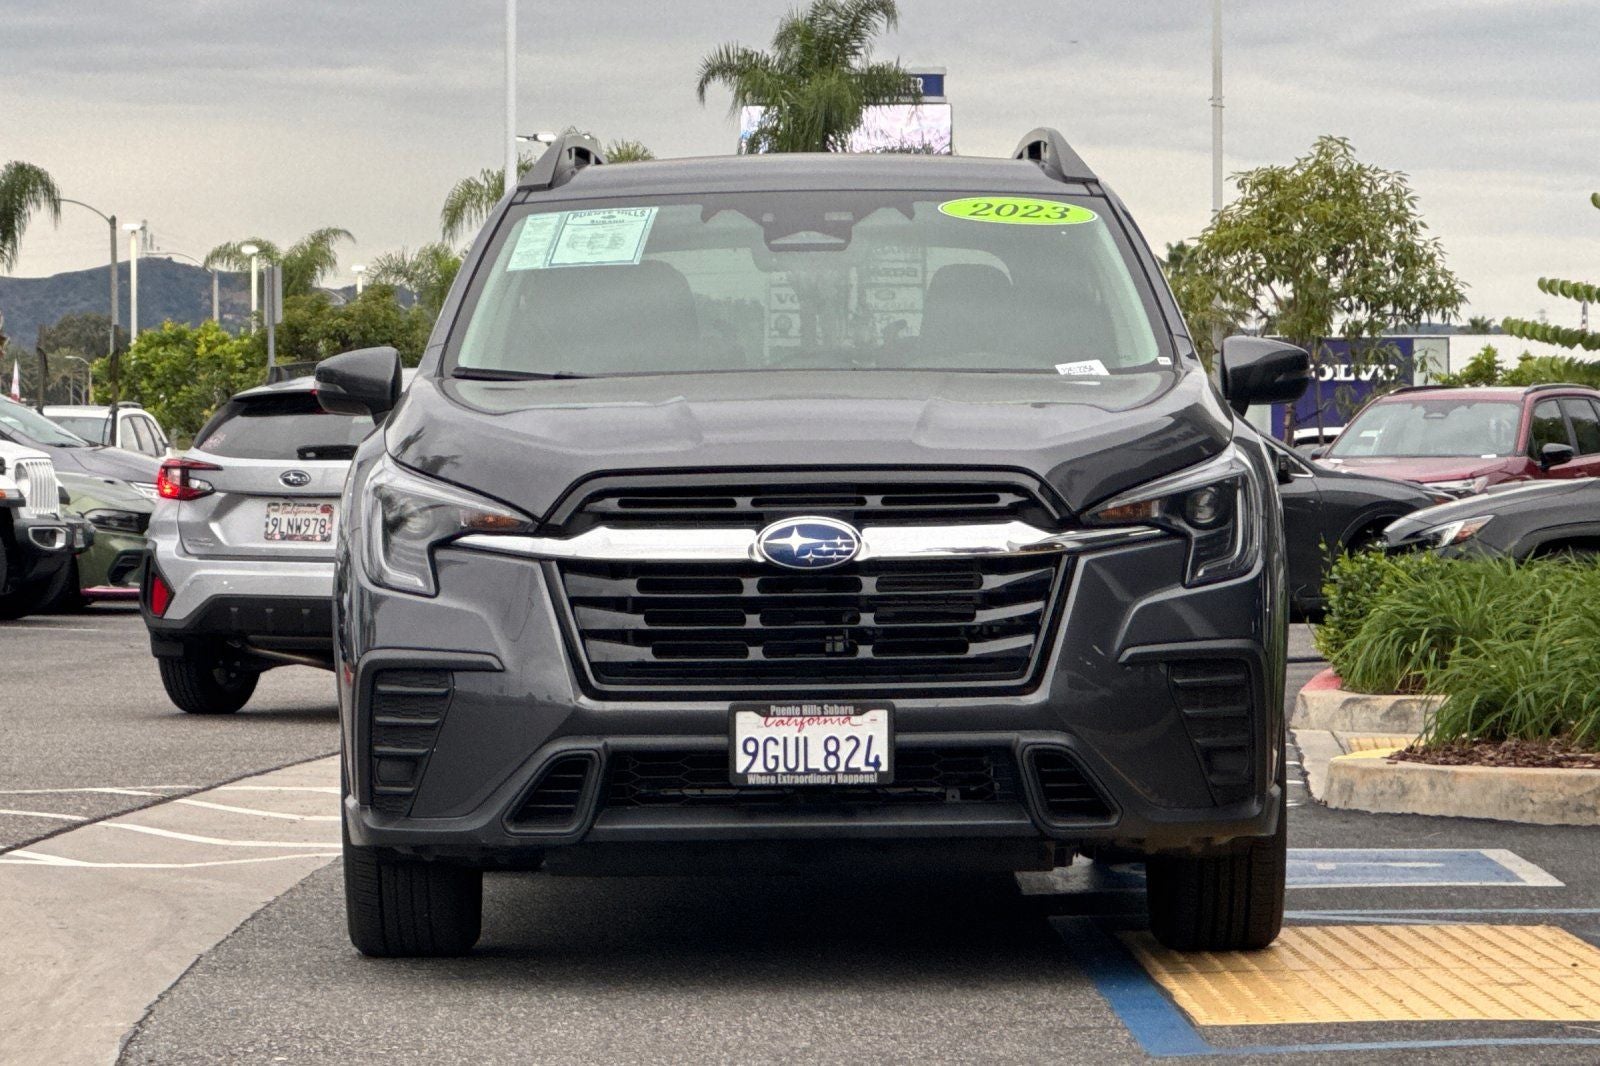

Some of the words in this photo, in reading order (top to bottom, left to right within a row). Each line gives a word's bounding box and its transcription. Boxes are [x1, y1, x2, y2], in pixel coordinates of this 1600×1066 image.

[968, 202, 1071, 220] 2023
[1308, 363, 1399, 382] OLVO
[271, 517, 327, 535] 9LNW978
[770, 705, 800, 716] Puente
[802, 705, 822, 716] Hills
[823, 705, 854, 715] Subaru
[762, 715, 863, 733] California
[742, 735, 882, 773] 9GUL824
[747, 773, 776, 784] Where
[777, 773, 836, 785] Extraordinary
[837, 772, 878, 785] Happens!
